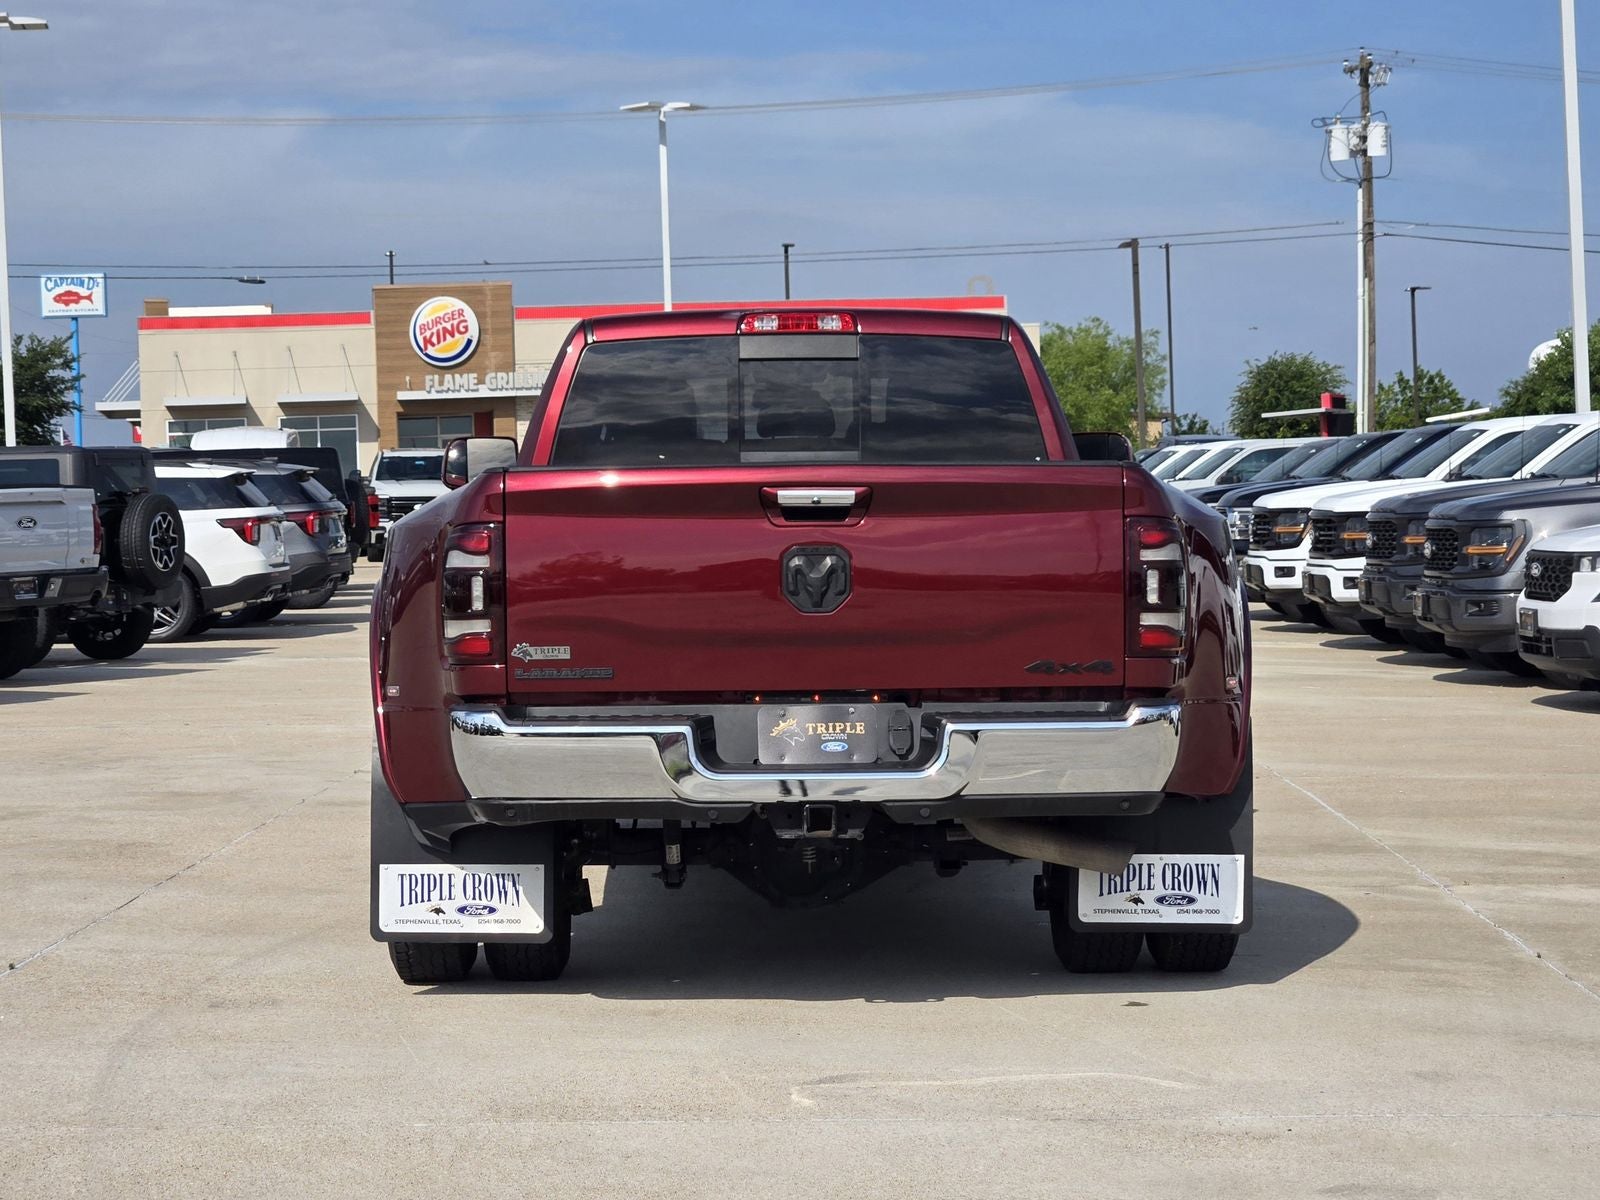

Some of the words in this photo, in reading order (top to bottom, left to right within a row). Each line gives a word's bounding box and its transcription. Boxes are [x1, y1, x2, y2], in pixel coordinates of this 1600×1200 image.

[418, 308, 466, 337] BURGER
[421, 319, 470, 353] KING
[424, 373, 479, 393] FLAME
[532, 647, 569, 655] TRIPLE
[806, 722, 866, 735] TRIPLE
[397, 872, 457, 907] TRIPLE
[462, 872, 521, 908] CROWN
[1161, 862, 1221, 898] CROWN
[463, 904, 490, 916] Ford
[1163, 894, 1189, 906] Ford
